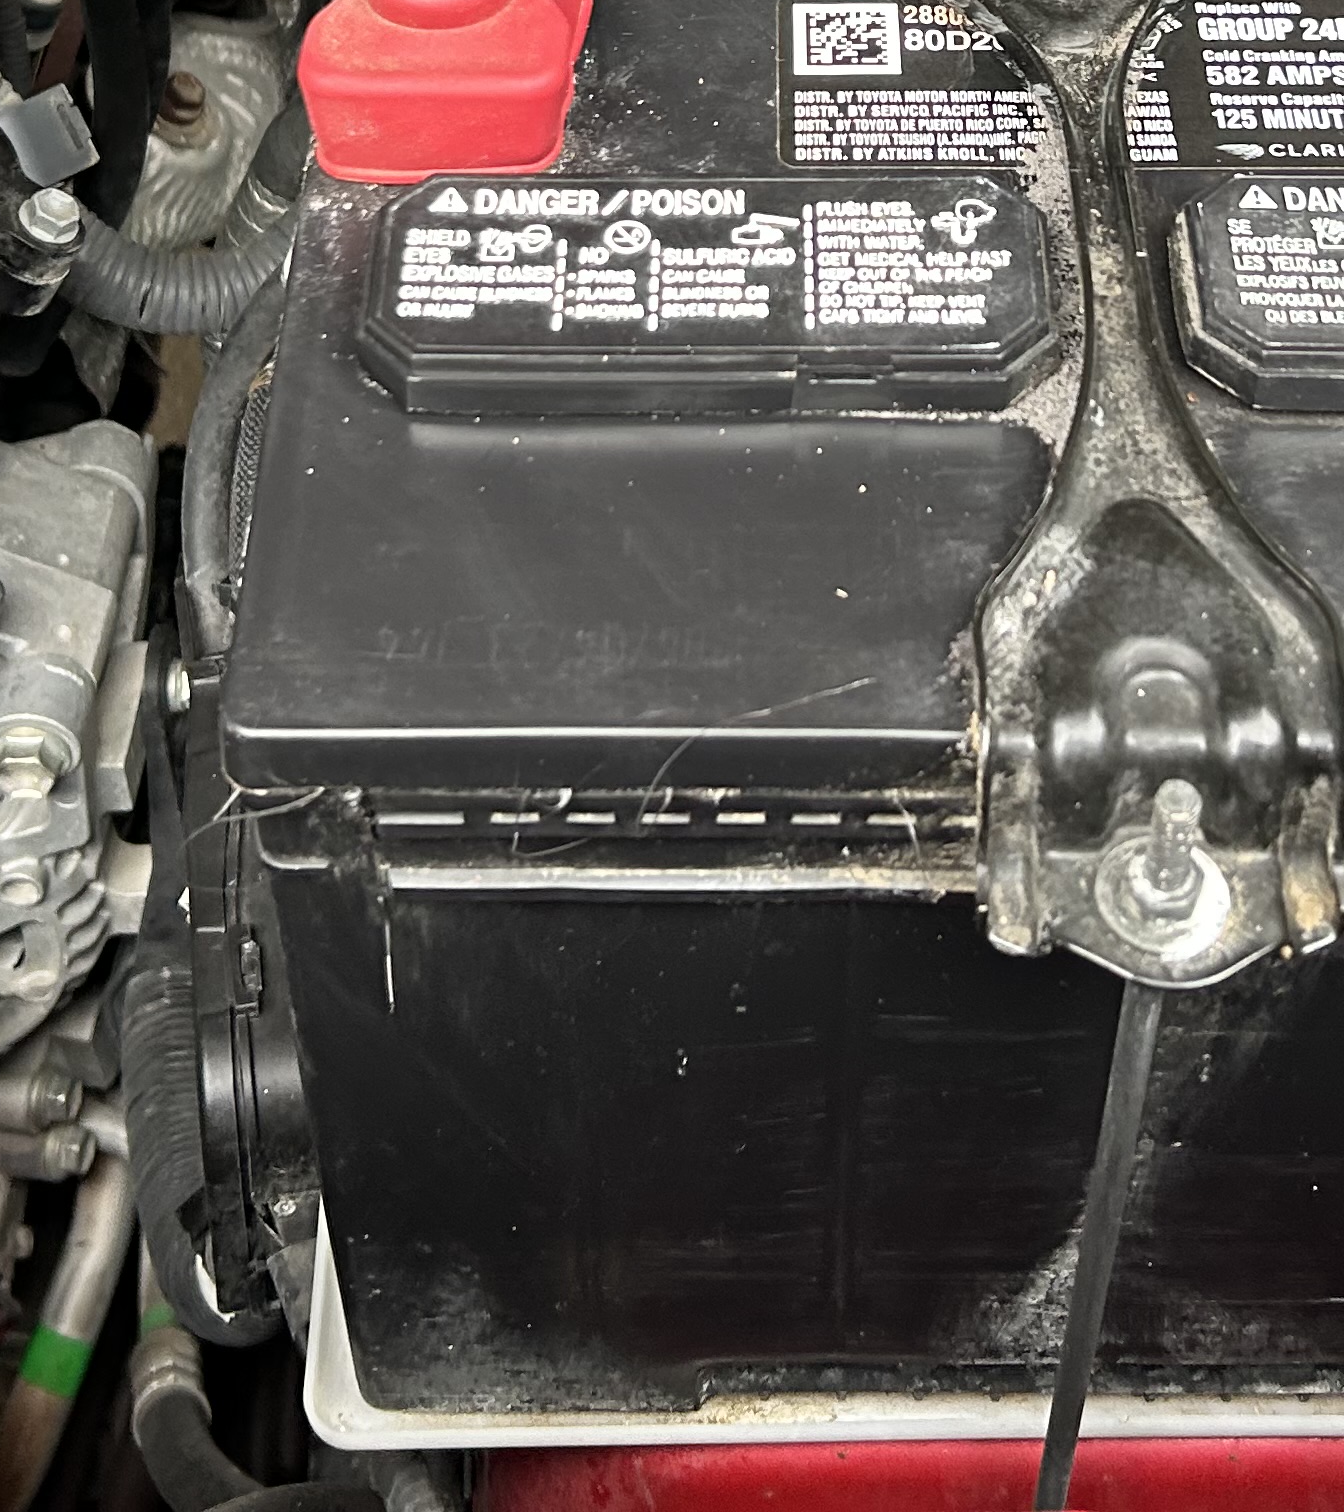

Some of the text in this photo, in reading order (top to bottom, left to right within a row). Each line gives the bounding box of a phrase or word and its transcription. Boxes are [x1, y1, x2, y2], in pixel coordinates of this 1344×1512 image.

[1194, 1, 1302, 16] Replace With
[1197, 17, 1294, 41] GROUP
[1202, 49, 1240, 63] Cold
[1242, 49, 1316, 65] Cranking
[1206, 65, 1260, 86] 582
[794, 90, 835, 104] DISTR.
[837, 90, 854, 104] BY
[855, 90, 902, 104] TOYOTA
[905, 90, 948, 104] MOTOR
[950, 90, 992, 104] NORTH
[1209, 92, 1279, 106] Reserve
[794, 105, 844, 118] DISTR.
[847, 105, 868, 118] BY
[932, 105, 989, 117] PACIFIC
[992, 104, 1023, 117] INC.
[1211, 108, 1258, 130] 125
[794, 119, 833, 133] DISTR.
[836, 119, 851, 132] BY
[854, 119, 899, 132] TOYOTA
[900, 119, 917, 132] DE
[918, 119, 963, 132] PUERTO
[965, 119, 994, 131] RICO
[996, 117, 1031, 131] CORP.
[1143, 119, 1174, 132] RICO
[794, 133, 831, 147] DISTR.
[833, 133, 847, 146] BY
[849, 133, 892, 146] TOYOTA
[893, 133, 936, 146] TSUSHO
[1136, 133, 1178, 147] SAMOA
[795, 148, 848, 161] DISTR.
[852, 148, 874, 161] BY
[877, 148, 934, 161] ATKINS
[937, 148, 994, 163] KROLL,
[1129, 148, 1179, 162] GUAM
[473, 188, 600, 216] DANGER
[630, 188, 746, 216] POISON
[816, 201, 868, 217] FLUSH
[817, 218, 926, 233] IMMEDIATELY
[1226, 218, 1254, 236] SE
[405, 227, 472, 247] SHIELD
[817, 235, 861, 250] WITH
[1230, 234, 1318, 255] PROTÉGER
[402, 246, 452, 265] EYES
[577, 246, 610, 265] NO
[661, 247, 797, 266] SULFURIC ACID
[817, 252, 851, 267] GET
[971, 250, 1012, 268] FAST
[1232, 254, 1266, 272] LES
[1266, 255, 1313, 273] YEUX
[1311, 259, 1339, 274] LES
[401, 264, 556, 284] EXPLOSIVE GASES
[856, 267, 888, 281] OUT
